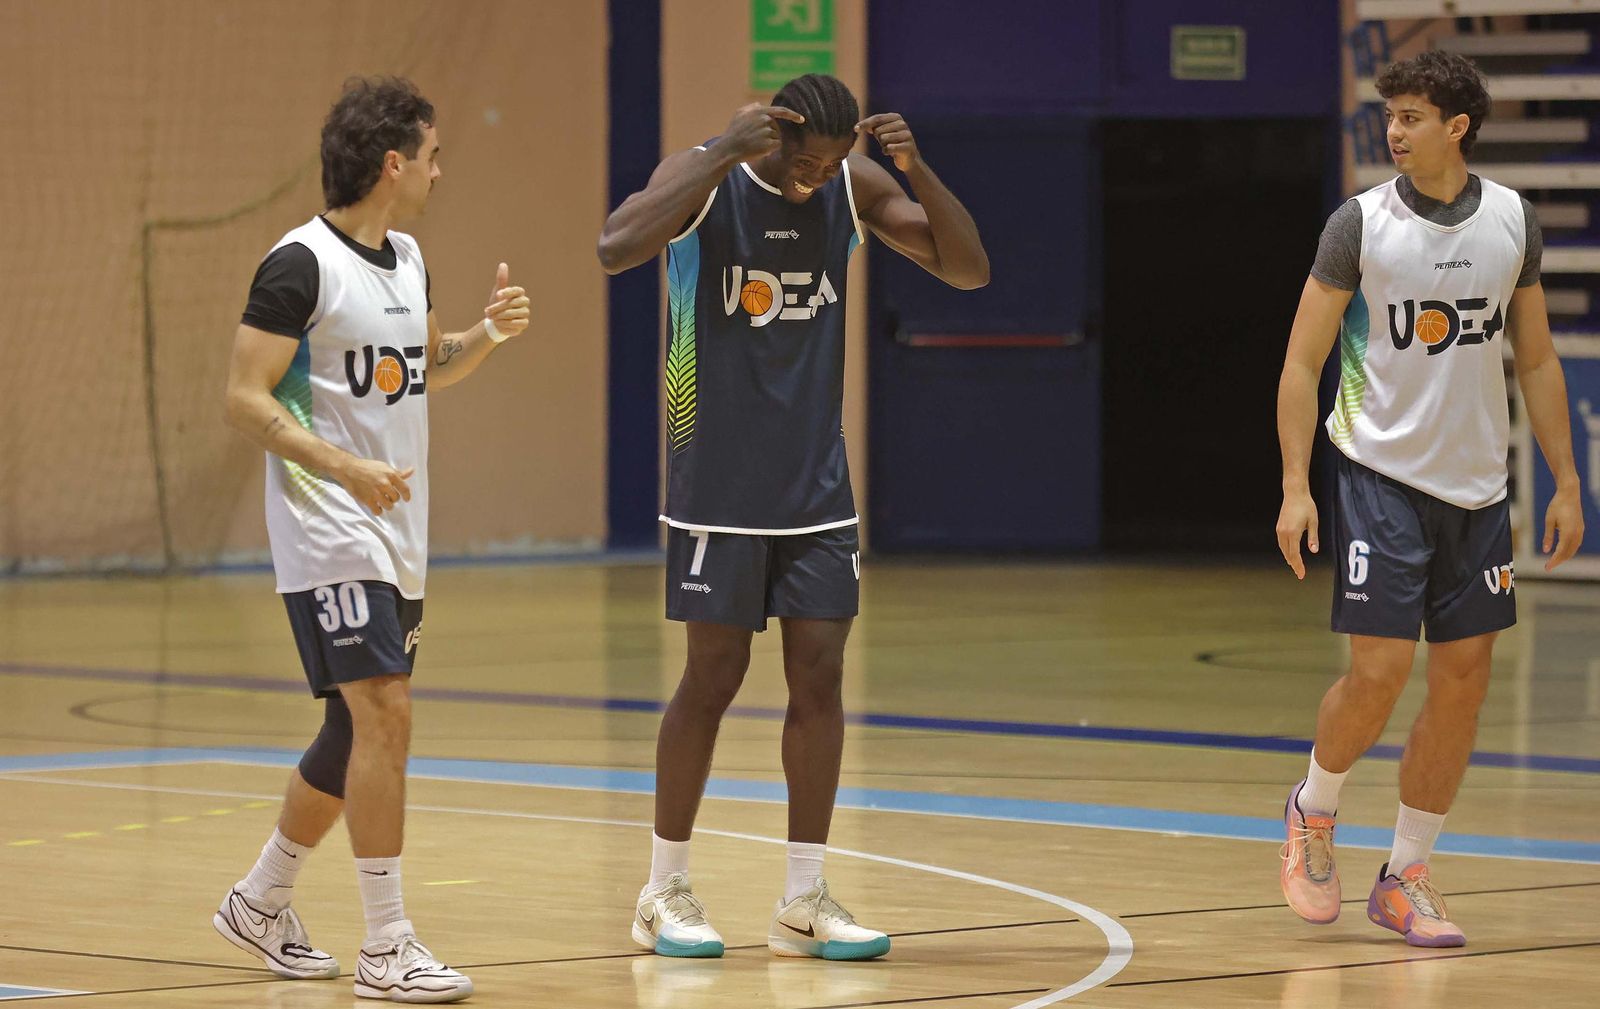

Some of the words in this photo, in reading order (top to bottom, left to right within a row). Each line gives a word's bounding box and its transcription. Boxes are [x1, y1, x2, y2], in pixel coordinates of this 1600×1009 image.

[1434, 261, 1462, 270] PENTEX
[722, 265, 838, 328] UDEA
[345, 344, 426, 406] UDE
[689, 530, 709, 577] 7
[1348, 539, 1370, 586] 6
[314, 581, 370, 633] 30
